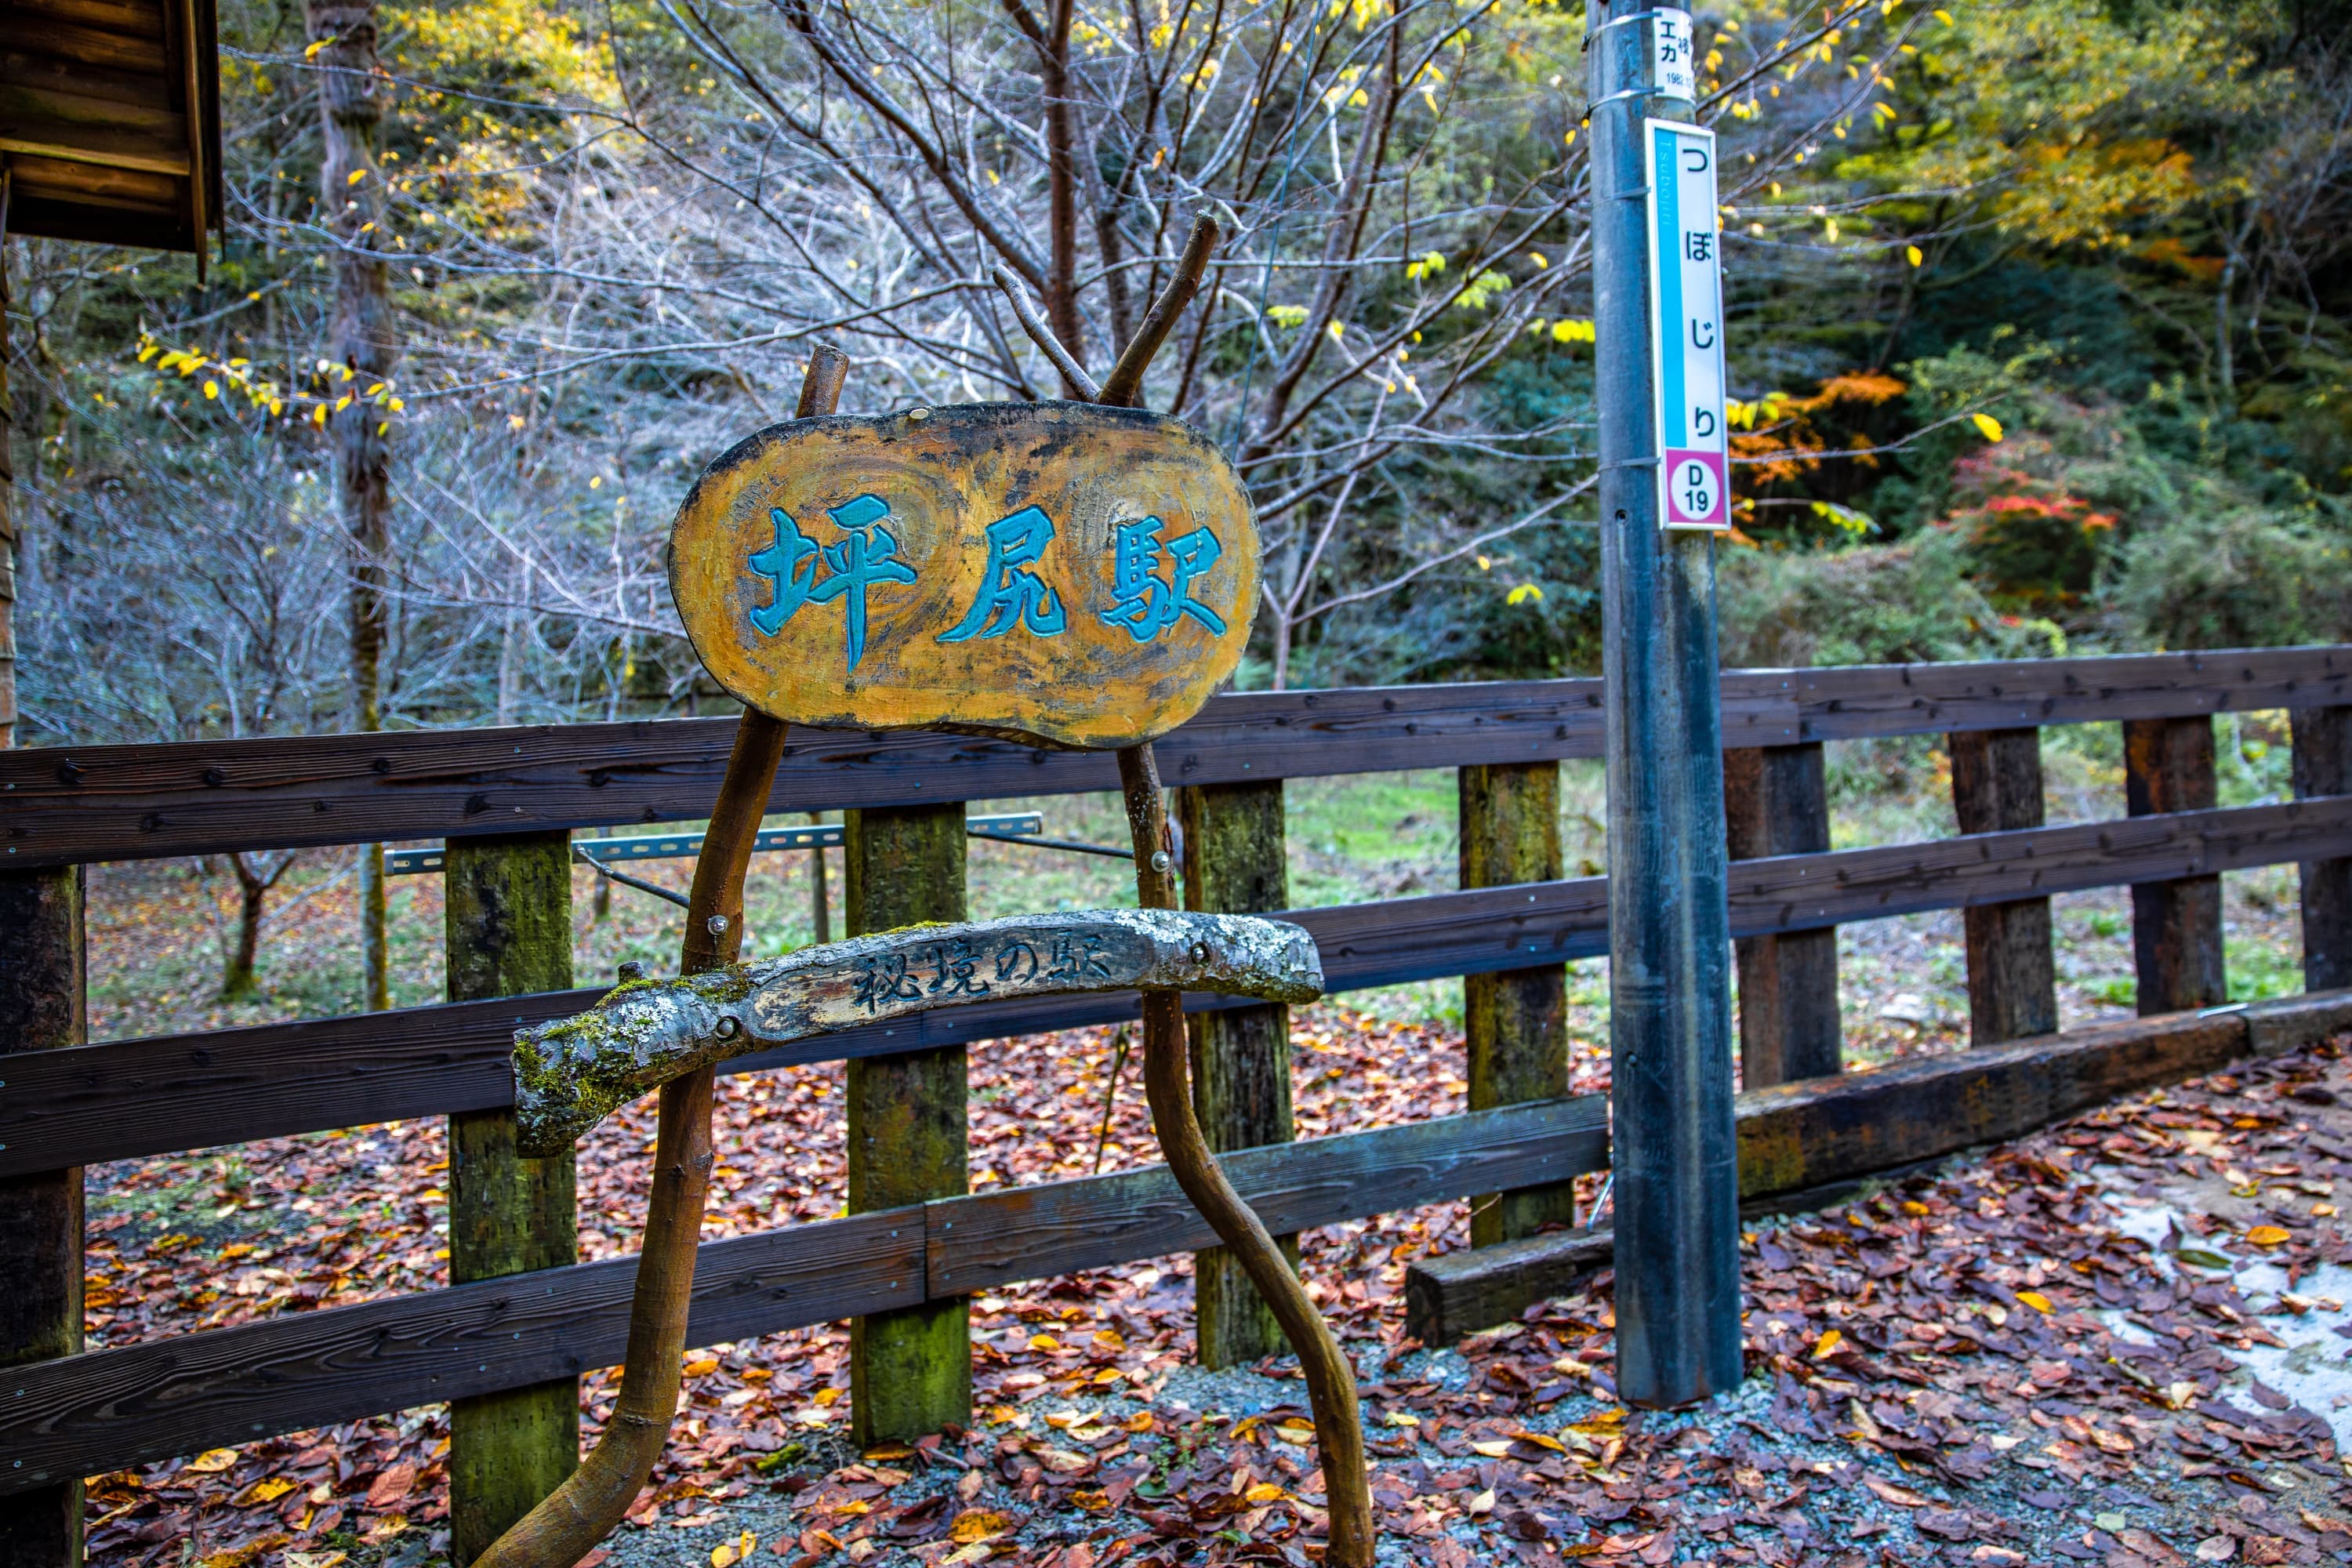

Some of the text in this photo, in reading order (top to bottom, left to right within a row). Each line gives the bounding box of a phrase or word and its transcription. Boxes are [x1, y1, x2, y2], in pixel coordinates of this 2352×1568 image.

[1682, 148, 1715, 437] つぼじり
[1686, 491, 1708, 511] 19
[1690, 465, 1703, 486] D
[749, 492, 1227, 673] 坪尻駅
[852, 930, 1111, 1014] 秘境の駅
